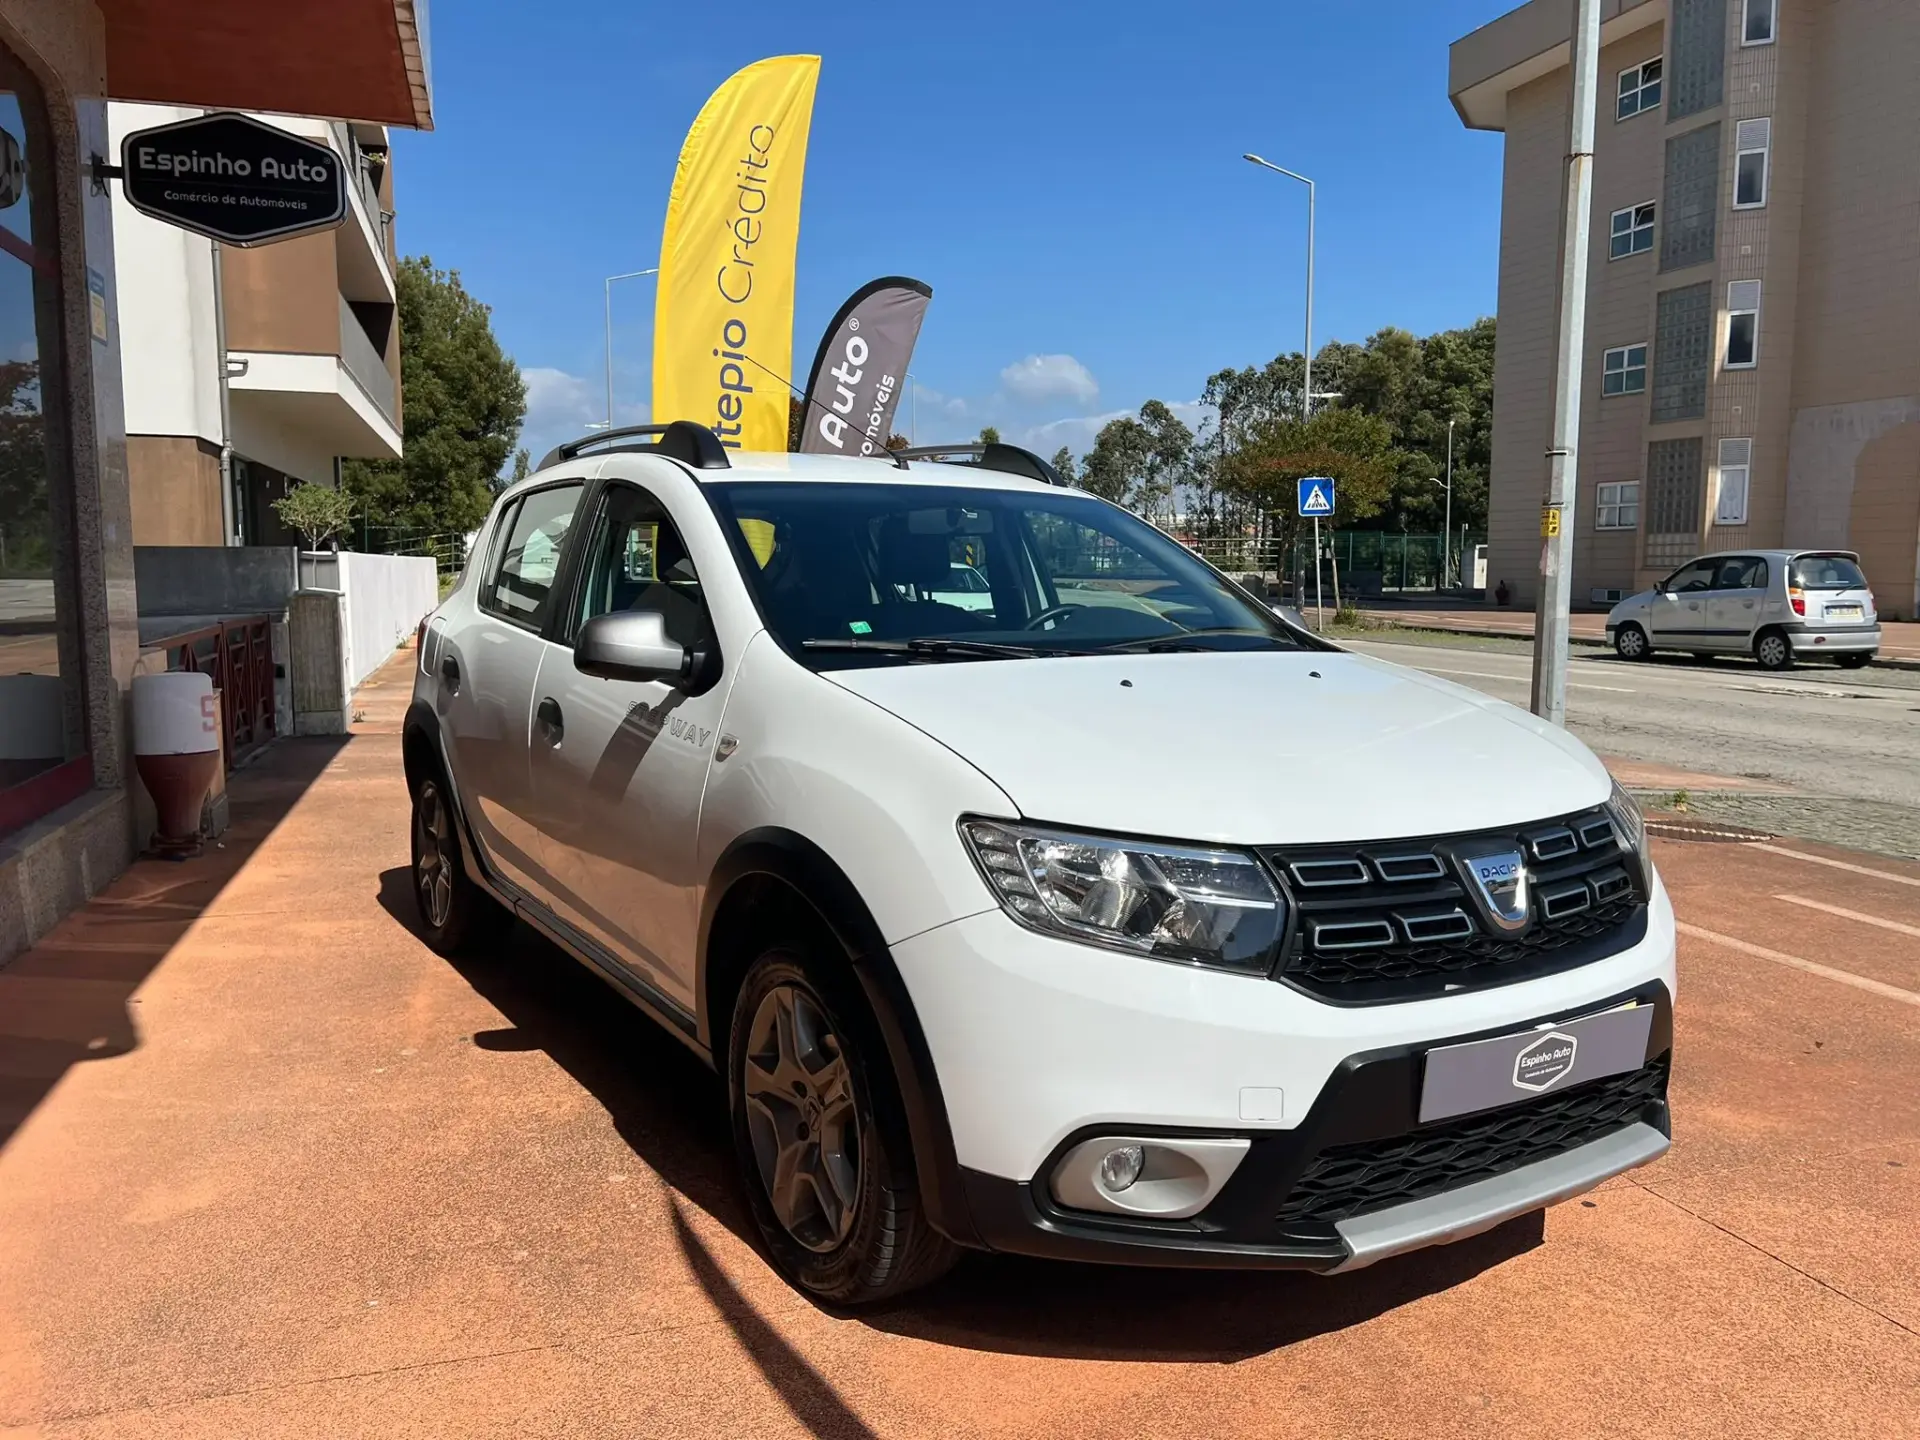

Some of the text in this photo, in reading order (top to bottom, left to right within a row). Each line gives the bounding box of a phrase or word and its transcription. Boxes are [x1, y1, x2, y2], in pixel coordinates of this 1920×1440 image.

[138, 147, 328, 182] Espinho Auto
[164, 190, 308, 210] Comércio de Automóveis
[717, 124, 775, 304] Crédito
[819, 336, 869, 449] Auto
[859, 374, 896, 457] omóveis
[1480, 863, 1518, 879] DACIA
[1521, 1046, 1572, 1068] Espinho Auto
